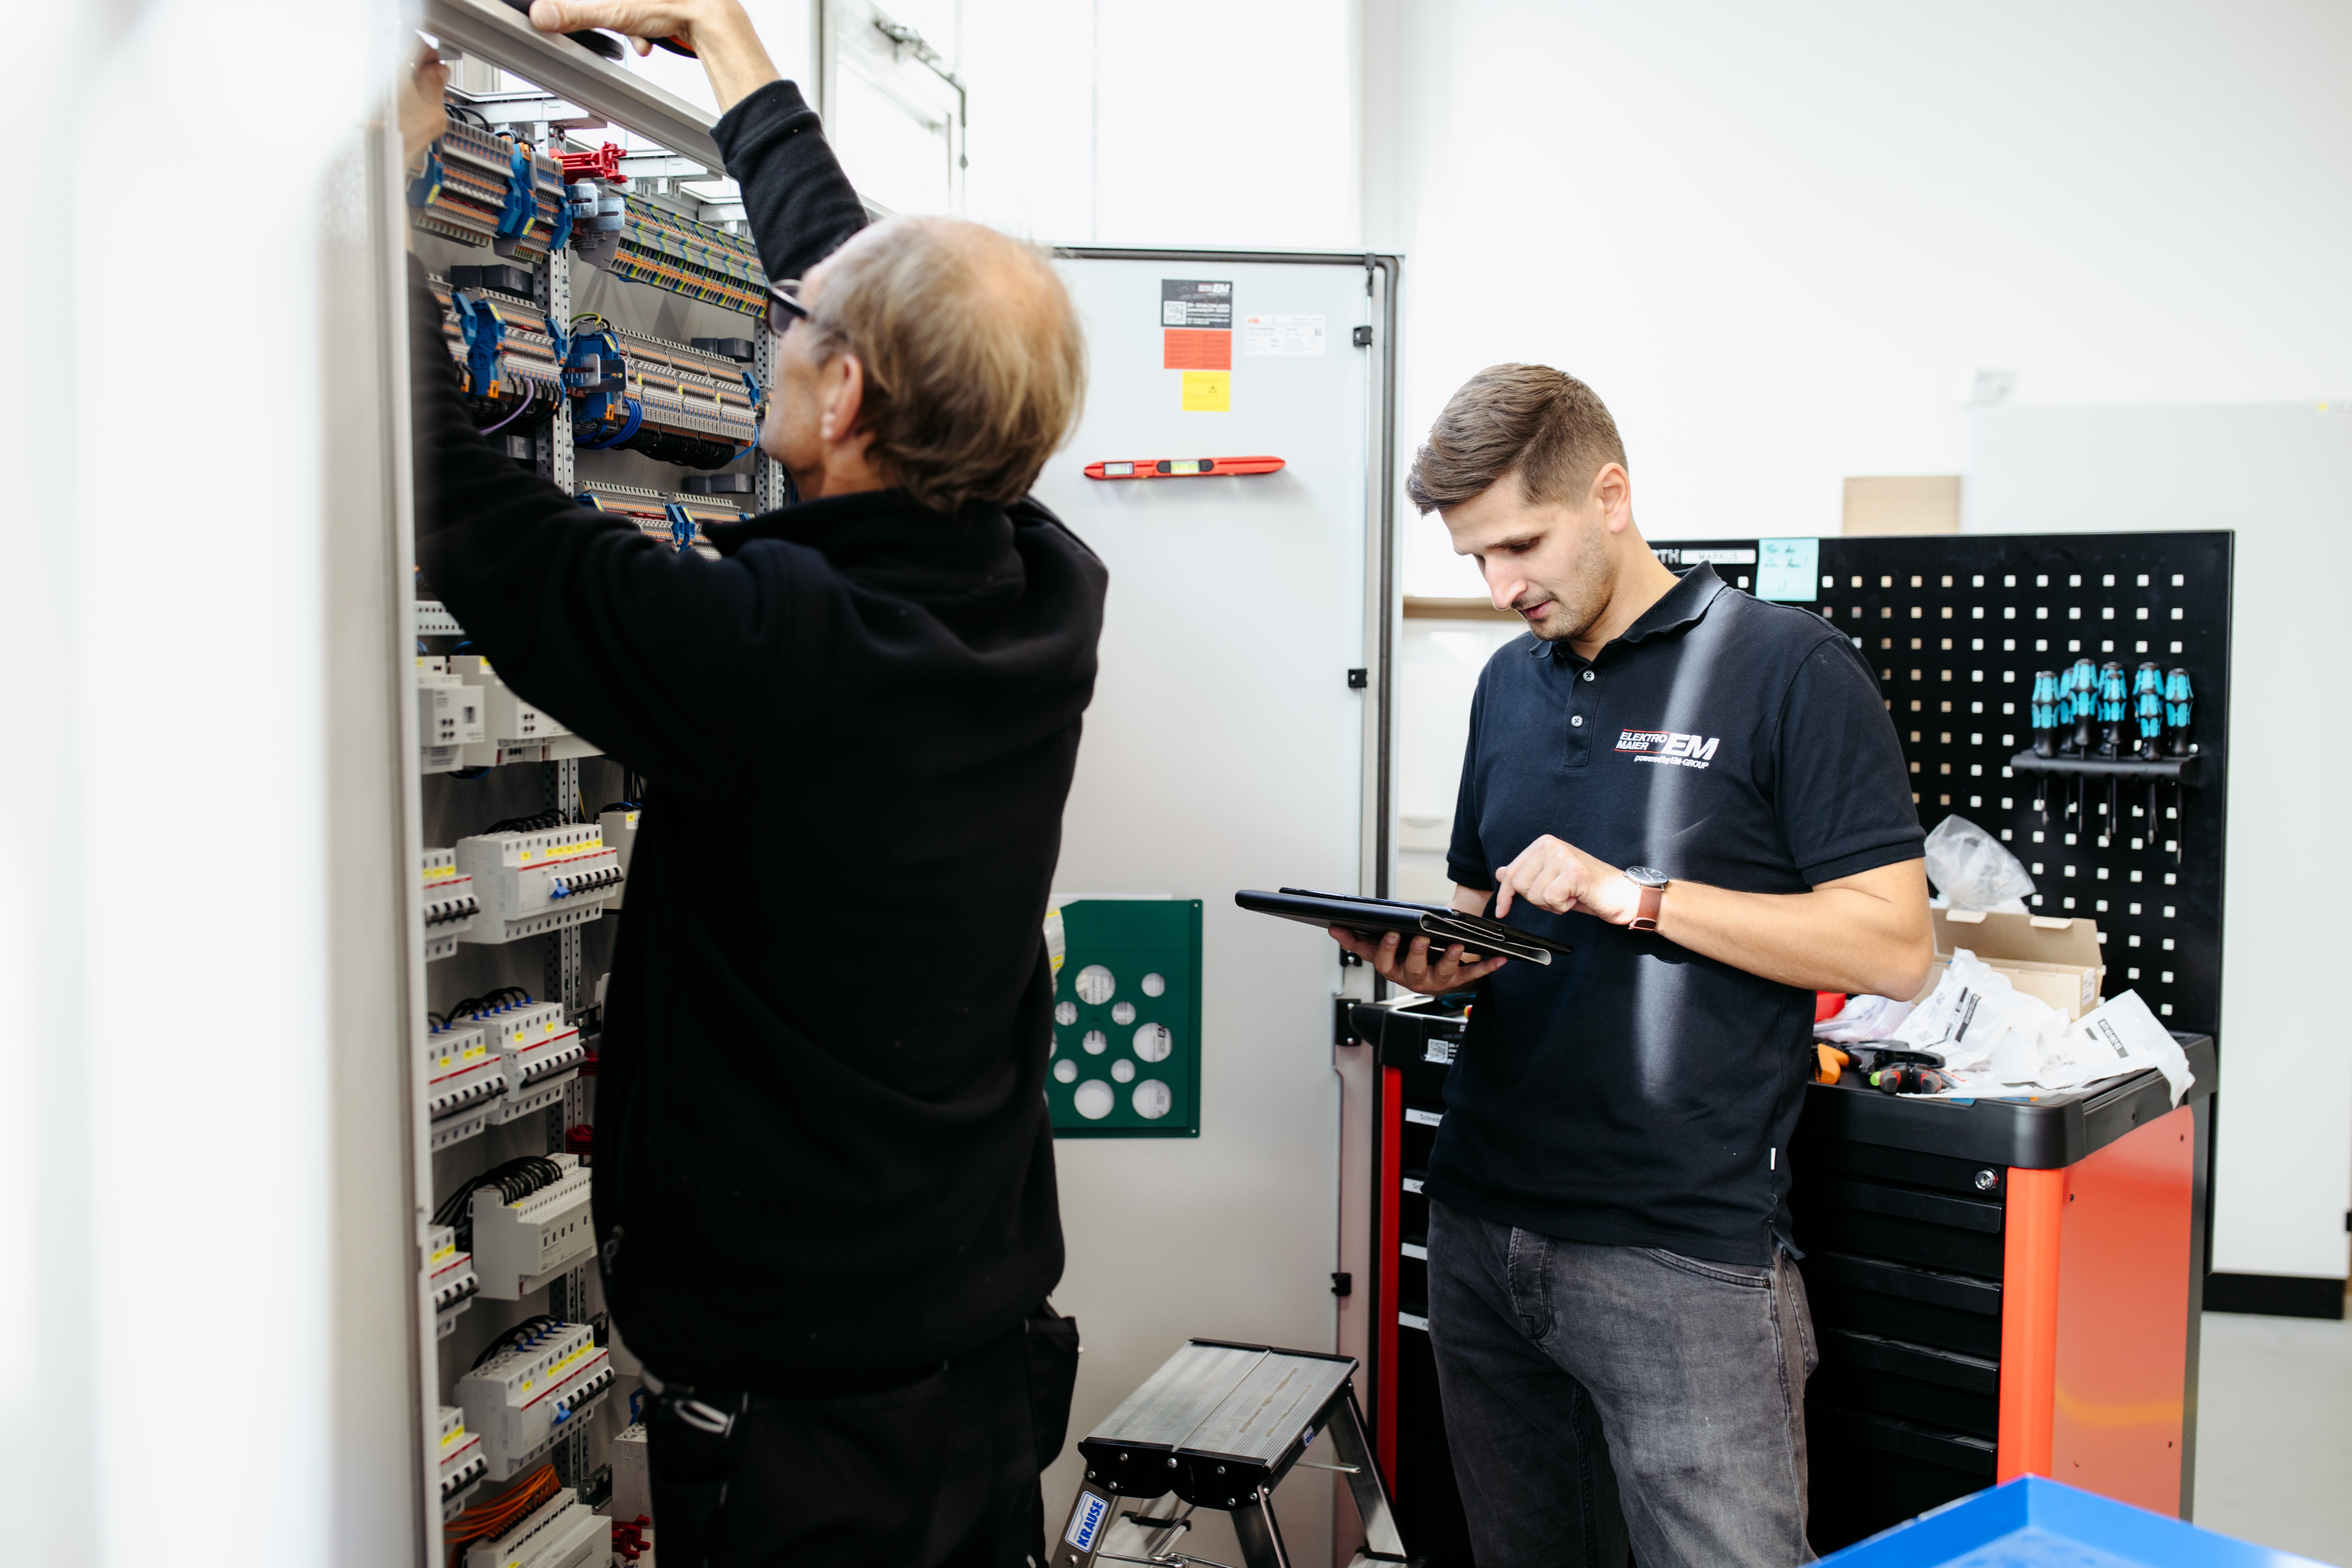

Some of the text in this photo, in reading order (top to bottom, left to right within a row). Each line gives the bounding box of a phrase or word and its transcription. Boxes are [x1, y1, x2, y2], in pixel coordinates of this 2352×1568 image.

[1619, 732, 1668, 744] ELEKTRO
[1615, 740, 1650, 751] MAIER
[1661, 732, 1720, 760] EM
[1670, 756, 1709, 769] EM-GROUP
[1077, 1500, 1103, 1548] KRAUSE
